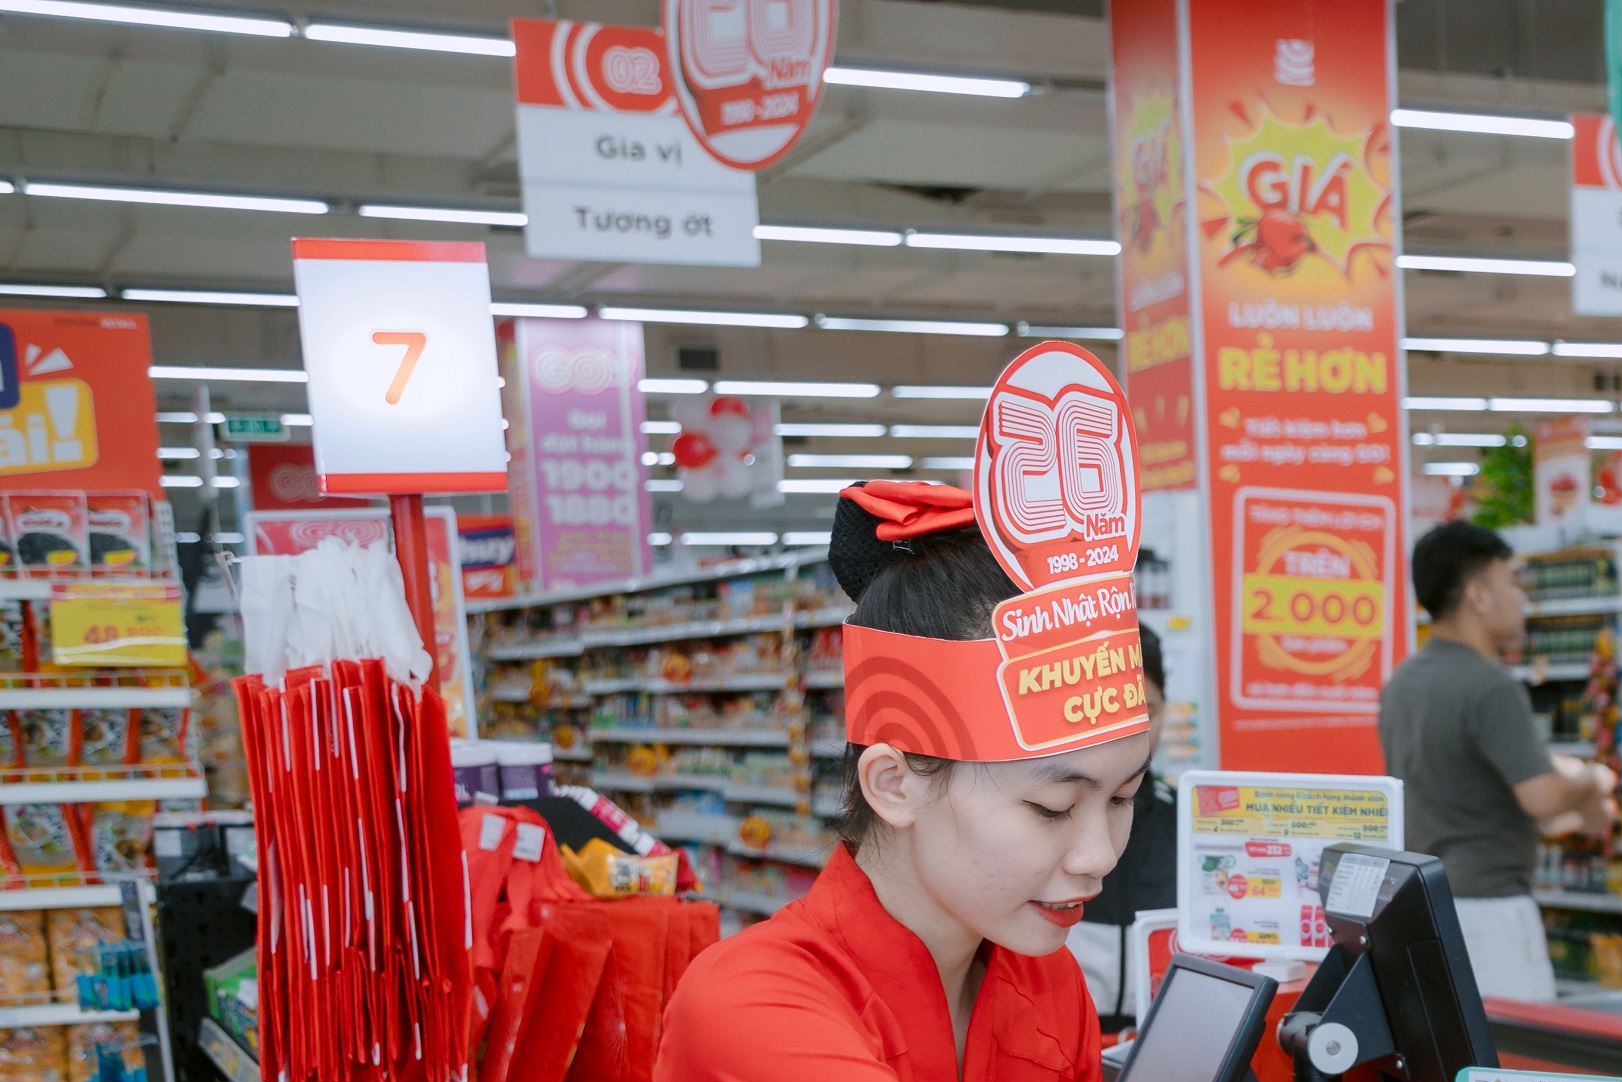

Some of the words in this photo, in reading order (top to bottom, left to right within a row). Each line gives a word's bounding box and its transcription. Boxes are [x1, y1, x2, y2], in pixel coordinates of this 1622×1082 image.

[604, 46, 661, 94] 02
[596, 136, 647, 161] Gia
[658, 143, 684, 168] vị
[1244, 153, 1356, 232] GIÁ
[574, 206, 672, 238] Tương
[681, 212, 714, 236] ớt
[1229, 299, 1298, 328] LUÔN
[1304, 303, 1373, 331] LUÔN
[370, 331, 427, 405] 7
[1219, 332, 1282, 391] RẺ
[1284, 347, 1387, 394] HƠN
[1000, 397, 1117, 533] 26
[1085, 513, 1125, 540] Năm
[1047, 555, 1078, 575] 1998
[1087, 545, 1119, 567] 2024
[1284, 550, 1349, 577] TRÊN
[1002, 606, 1053, 641] Sinh
[1051, 593, 1098, 627] Nhật
[1097, 586, 1131, 619] Rộn
[1018, 641, 1126, 695] KHUYẾN
[1064, 686, 1120, 724] CỰC
[1246, 803, 1268, 812] MUA
[1272, 801, 1303, 814] NHIỀU
[1306, 803, 1329, 814] TIẾT
[1333, 806, 1357, 816] KIỆM
